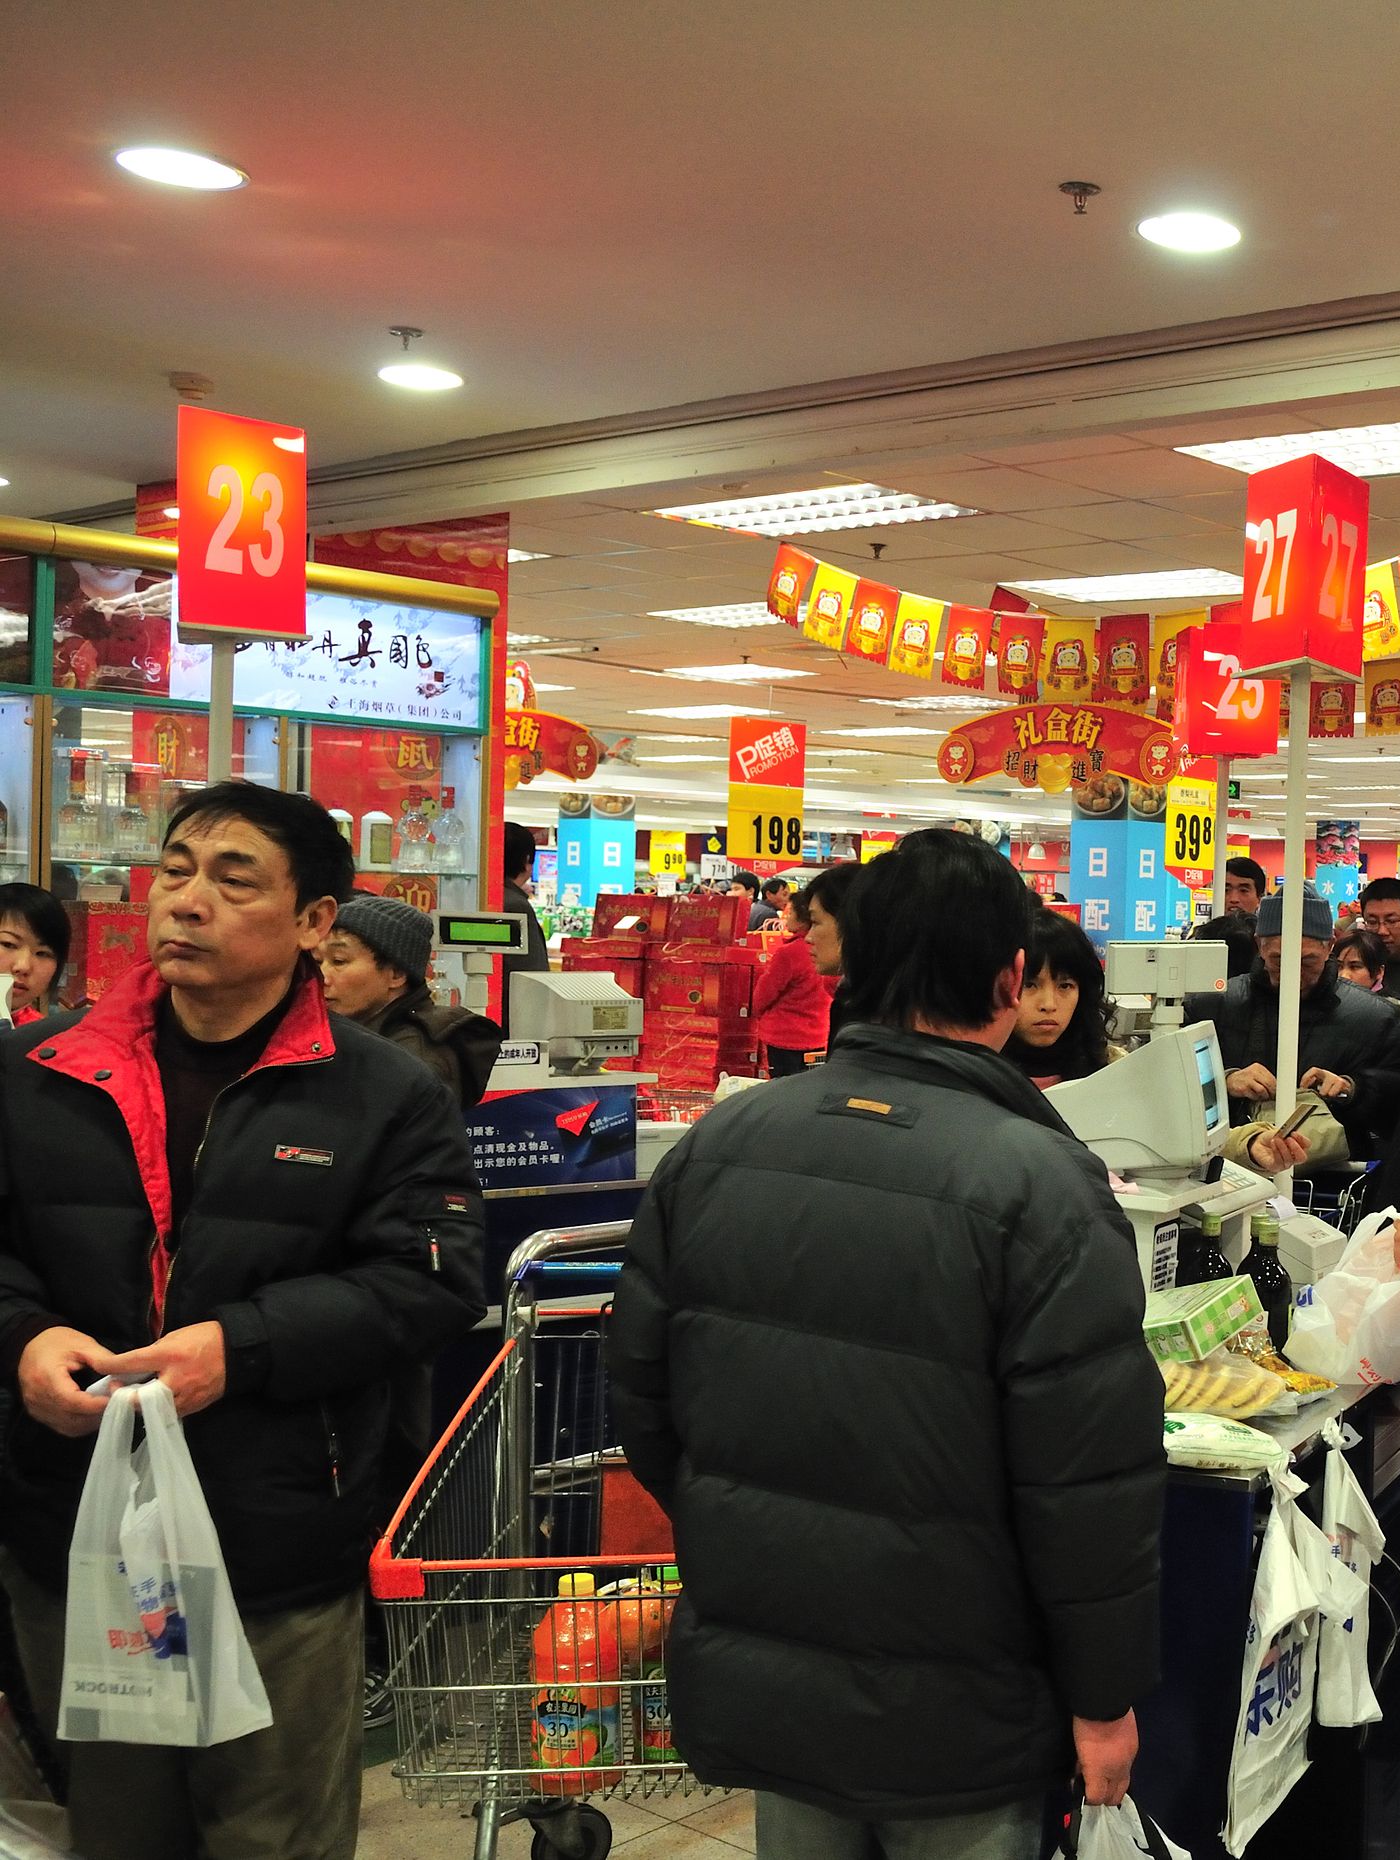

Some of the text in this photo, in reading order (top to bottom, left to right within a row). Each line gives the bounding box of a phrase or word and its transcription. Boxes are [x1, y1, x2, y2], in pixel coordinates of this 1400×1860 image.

[204, 464, 285, 577] 23
[1251, 508, 1298, 623] 27
[1319, 519, 1360, 633] 27
[1013, 706, 1104, 750] 礼盒街
[1215, 653, 1265, 720] 25
[755, 727, 796, 761] 促销
[753, 814, 801, 856] 198
[1084, 847, 1111, 932] 日配
[1134, 848, 1157, 932] 日配
